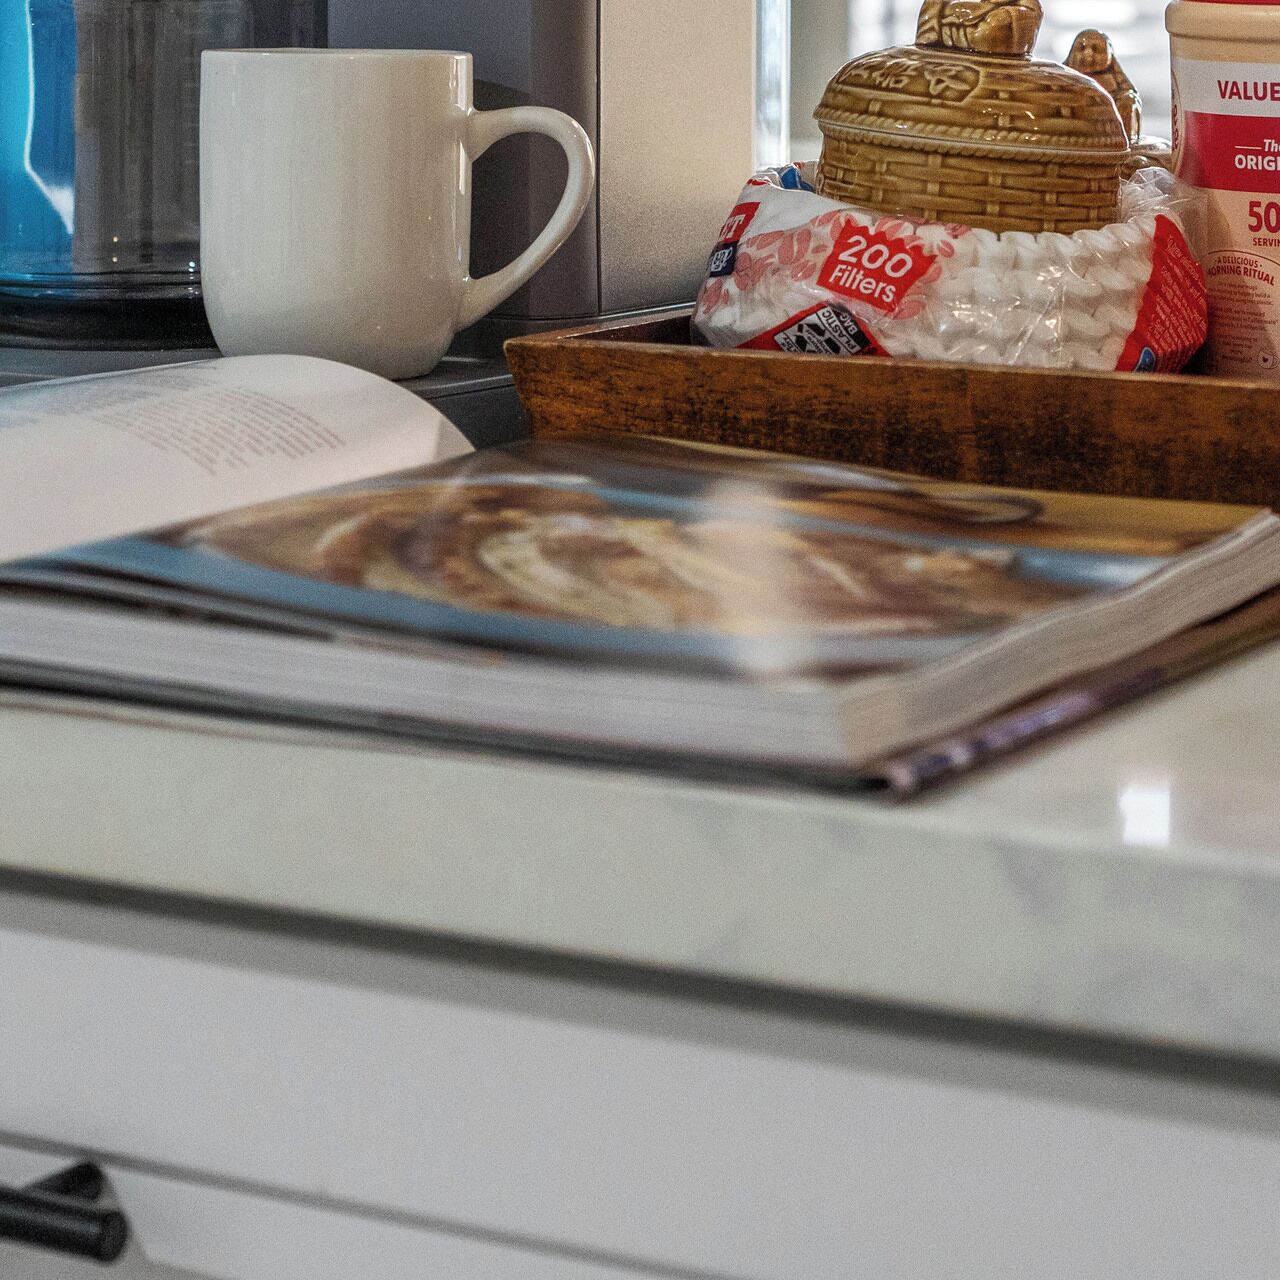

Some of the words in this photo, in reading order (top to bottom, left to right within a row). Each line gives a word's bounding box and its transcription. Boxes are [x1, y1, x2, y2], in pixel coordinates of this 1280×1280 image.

[838, 235, 913, 278] 200
[1222, 256, 1258, 268] DELICIOUS
[829, 263, 896, 302] Filters
[1242, 266, 1276, 287] RITUAL
[822, 309, 856, 352] PLASTIC
[840, 312, 858, 335] BAG
